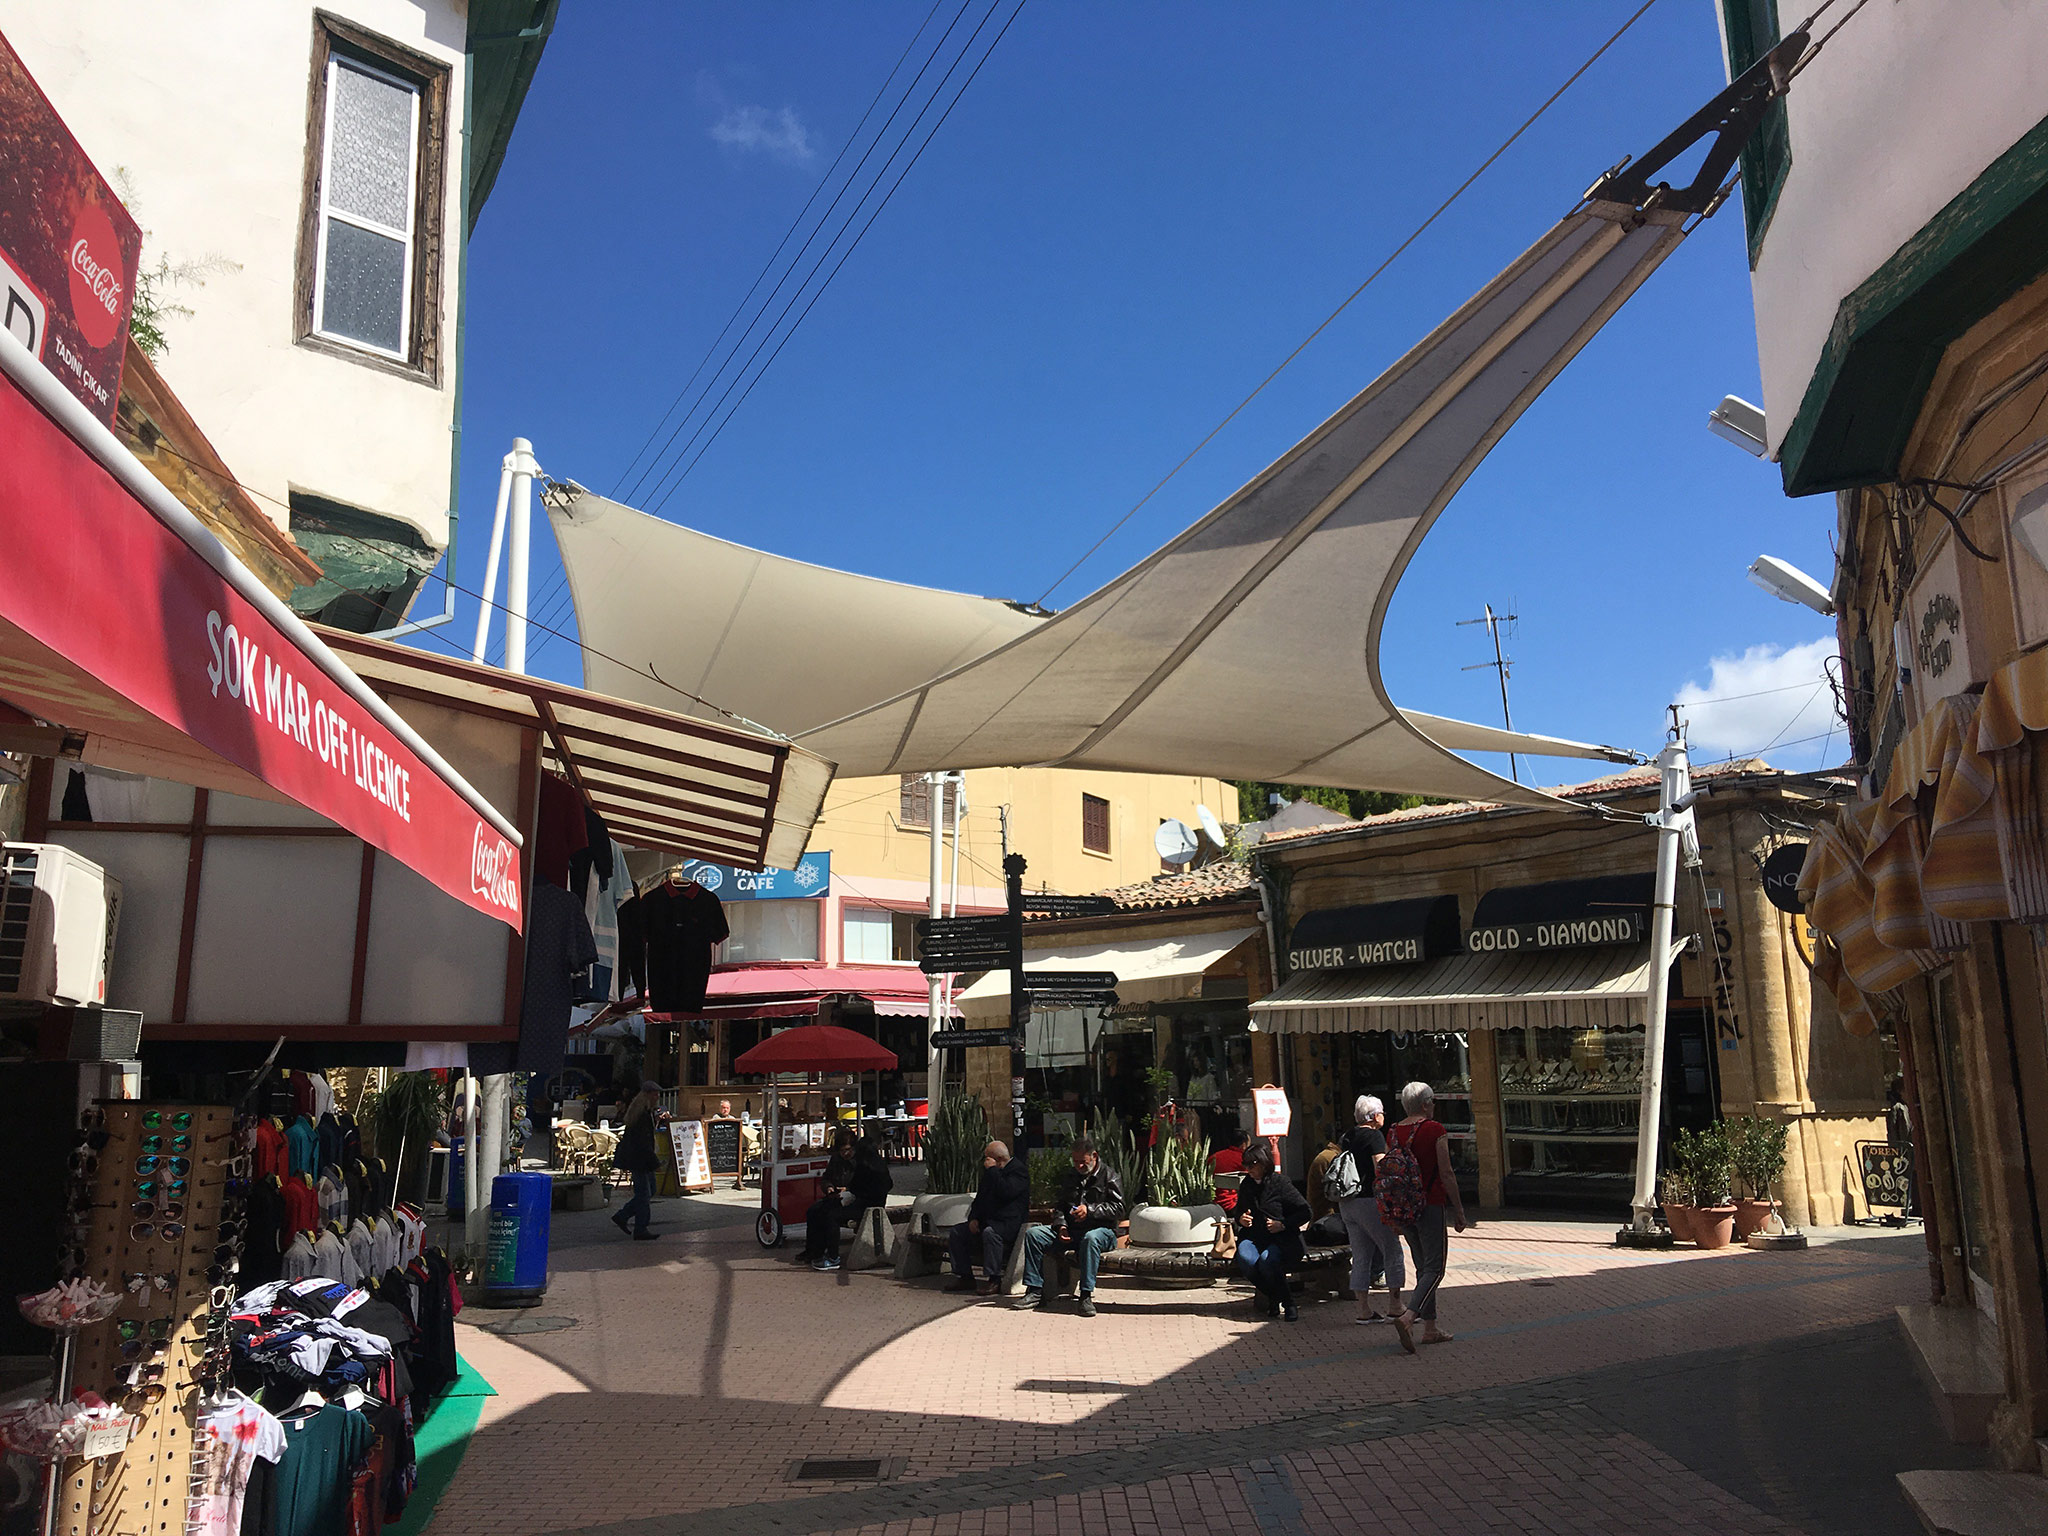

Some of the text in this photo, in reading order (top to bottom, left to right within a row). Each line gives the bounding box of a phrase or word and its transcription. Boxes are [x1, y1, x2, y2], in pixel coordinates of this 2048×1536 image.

[71, 238, 122, 315] Coca-Cola
[55, 337, 108, 406] TADINI ÇIKAR
[206, 610, 411, 824] ŞOK MAR OFF LICENCE
[471, 821, 518, 913] Coca-Cola
[696, 875, 720, 884] EFES
[737, 877, 775, 891] CAFE
[1289, 947, 1344, 970] SILVER
[1357, 940, 1418, 966] WATCH
[1469, 928, 1520, 952] GOLD
[1537, 918, 1631, 948] DIAMOND
[1712, 920, 1743, 1040] ÖREN
